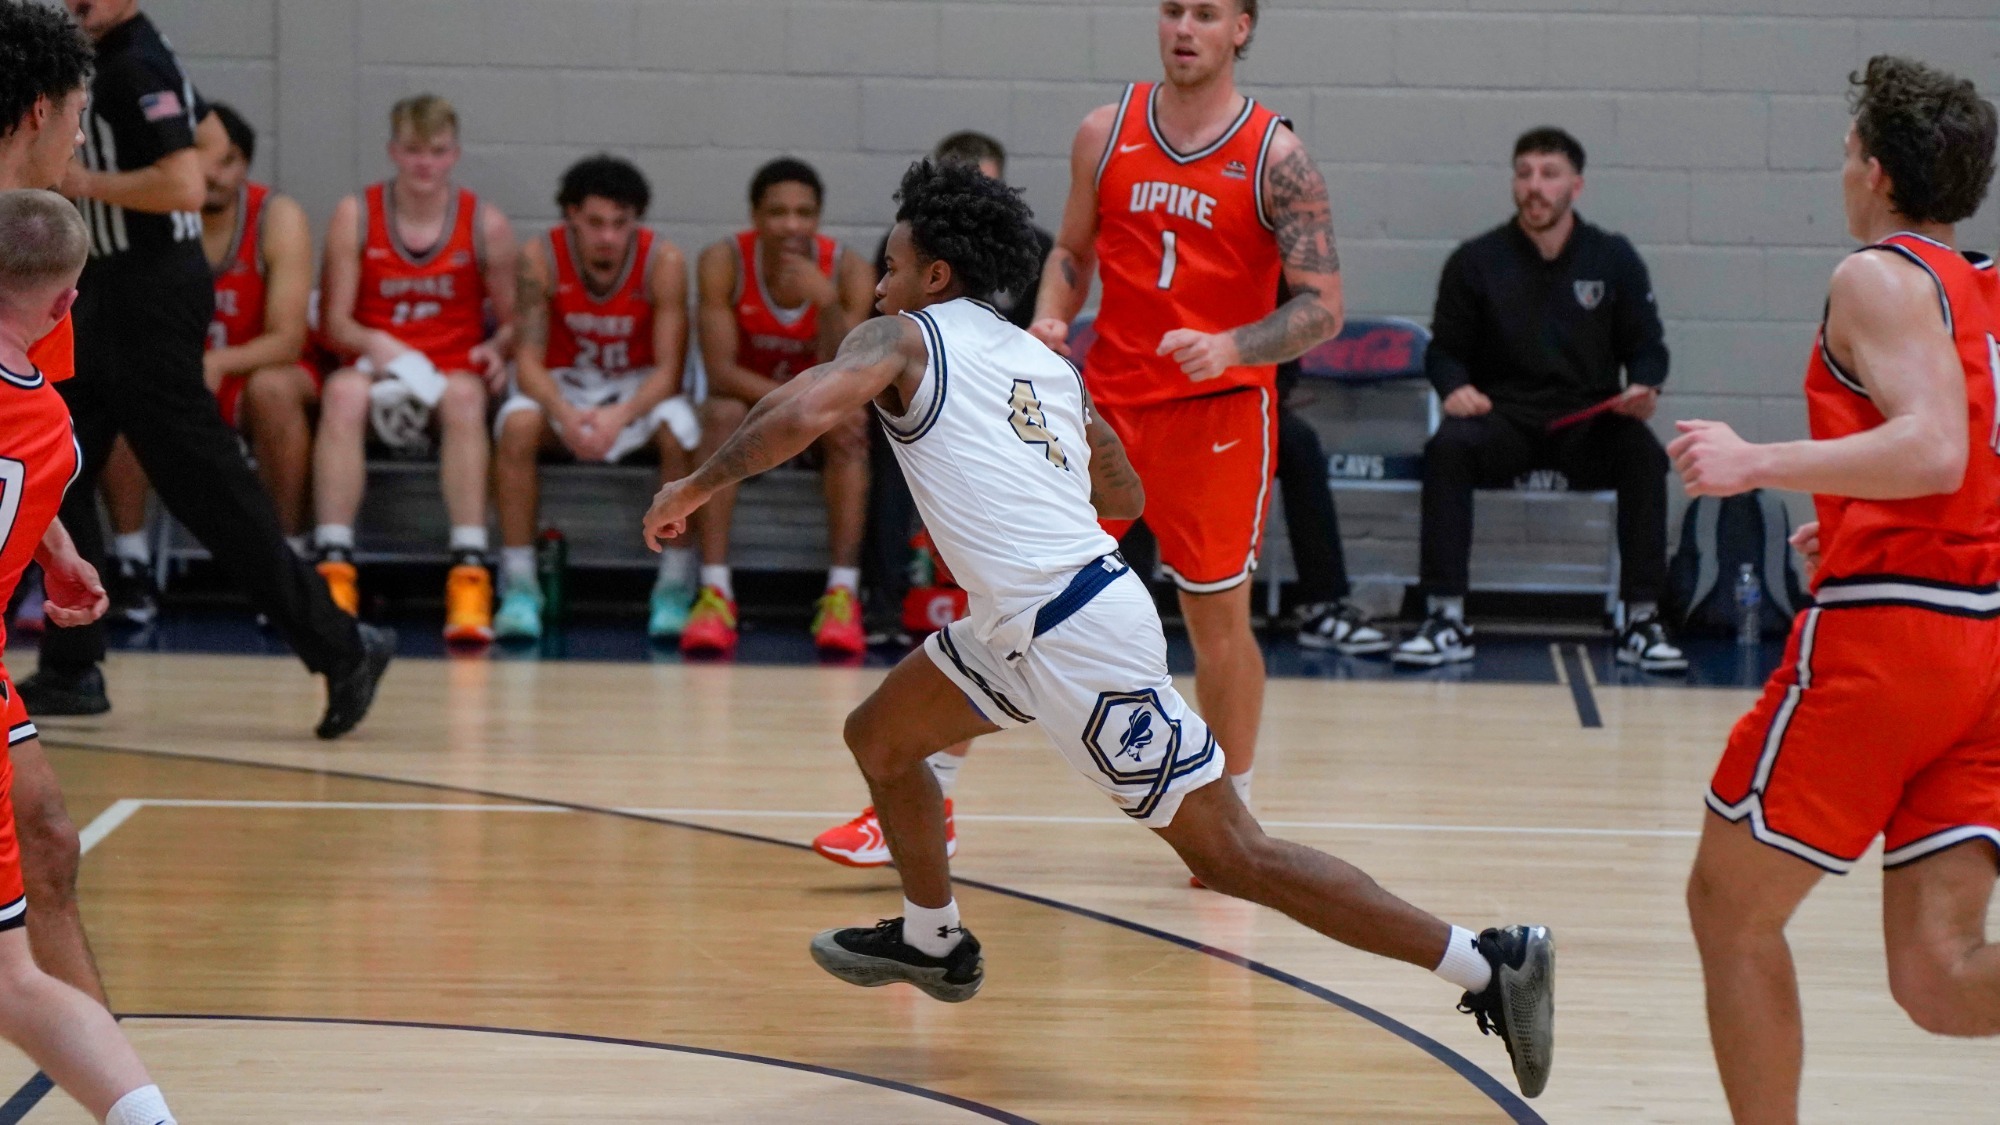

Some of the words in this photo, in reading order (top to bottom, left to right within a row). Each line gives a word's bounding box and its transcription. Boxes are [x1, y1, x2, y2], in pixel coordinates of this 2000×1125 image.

[1129, 181, 1218, 230] UPIKE
[1157, 229, 1176, 289] 1
[1007, 378, 1069, 472] 4
[1328, 454, 1385, 478] CAVS
[926, 595, 954, 628] G
